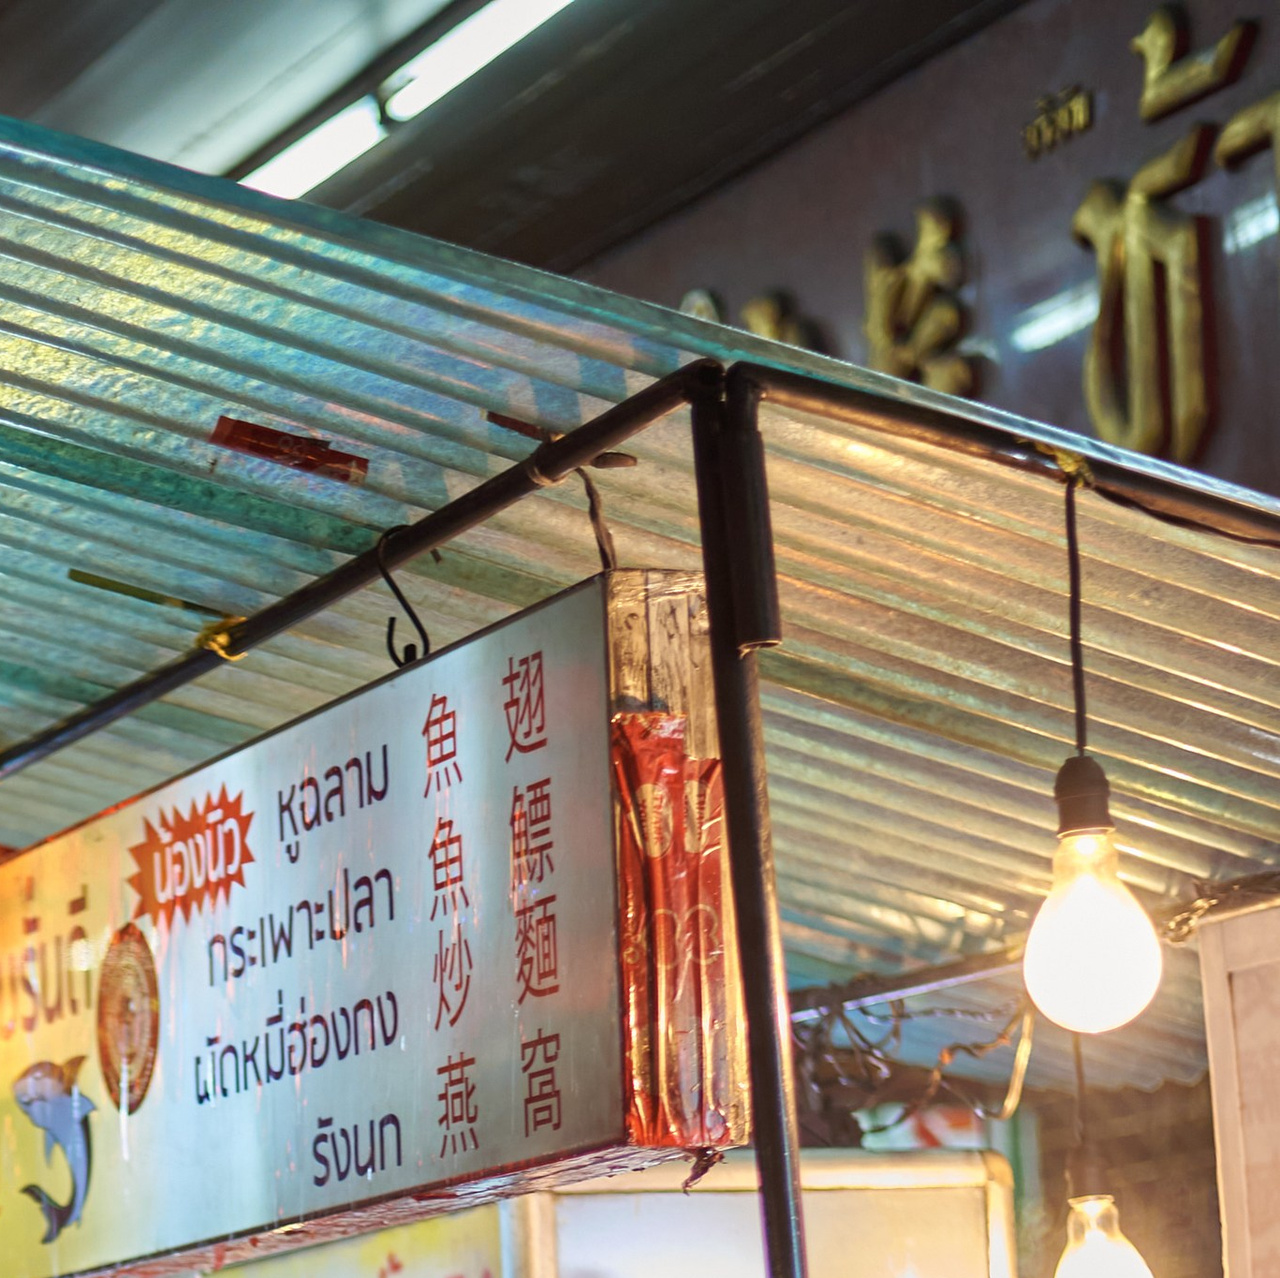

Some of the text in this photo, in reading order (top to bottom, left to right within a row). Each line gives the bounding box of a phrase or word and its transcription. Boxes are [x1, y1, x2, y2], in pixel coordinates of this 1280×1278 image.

[278, 744, 388, 863] หูฉลาม
[209, 867, 394, 986] กระเพาะปลา
[195, 989, 399, 1105] ผัดหมี่ฮ่องกง
[312, 1113, 402, 1187] รังนก
